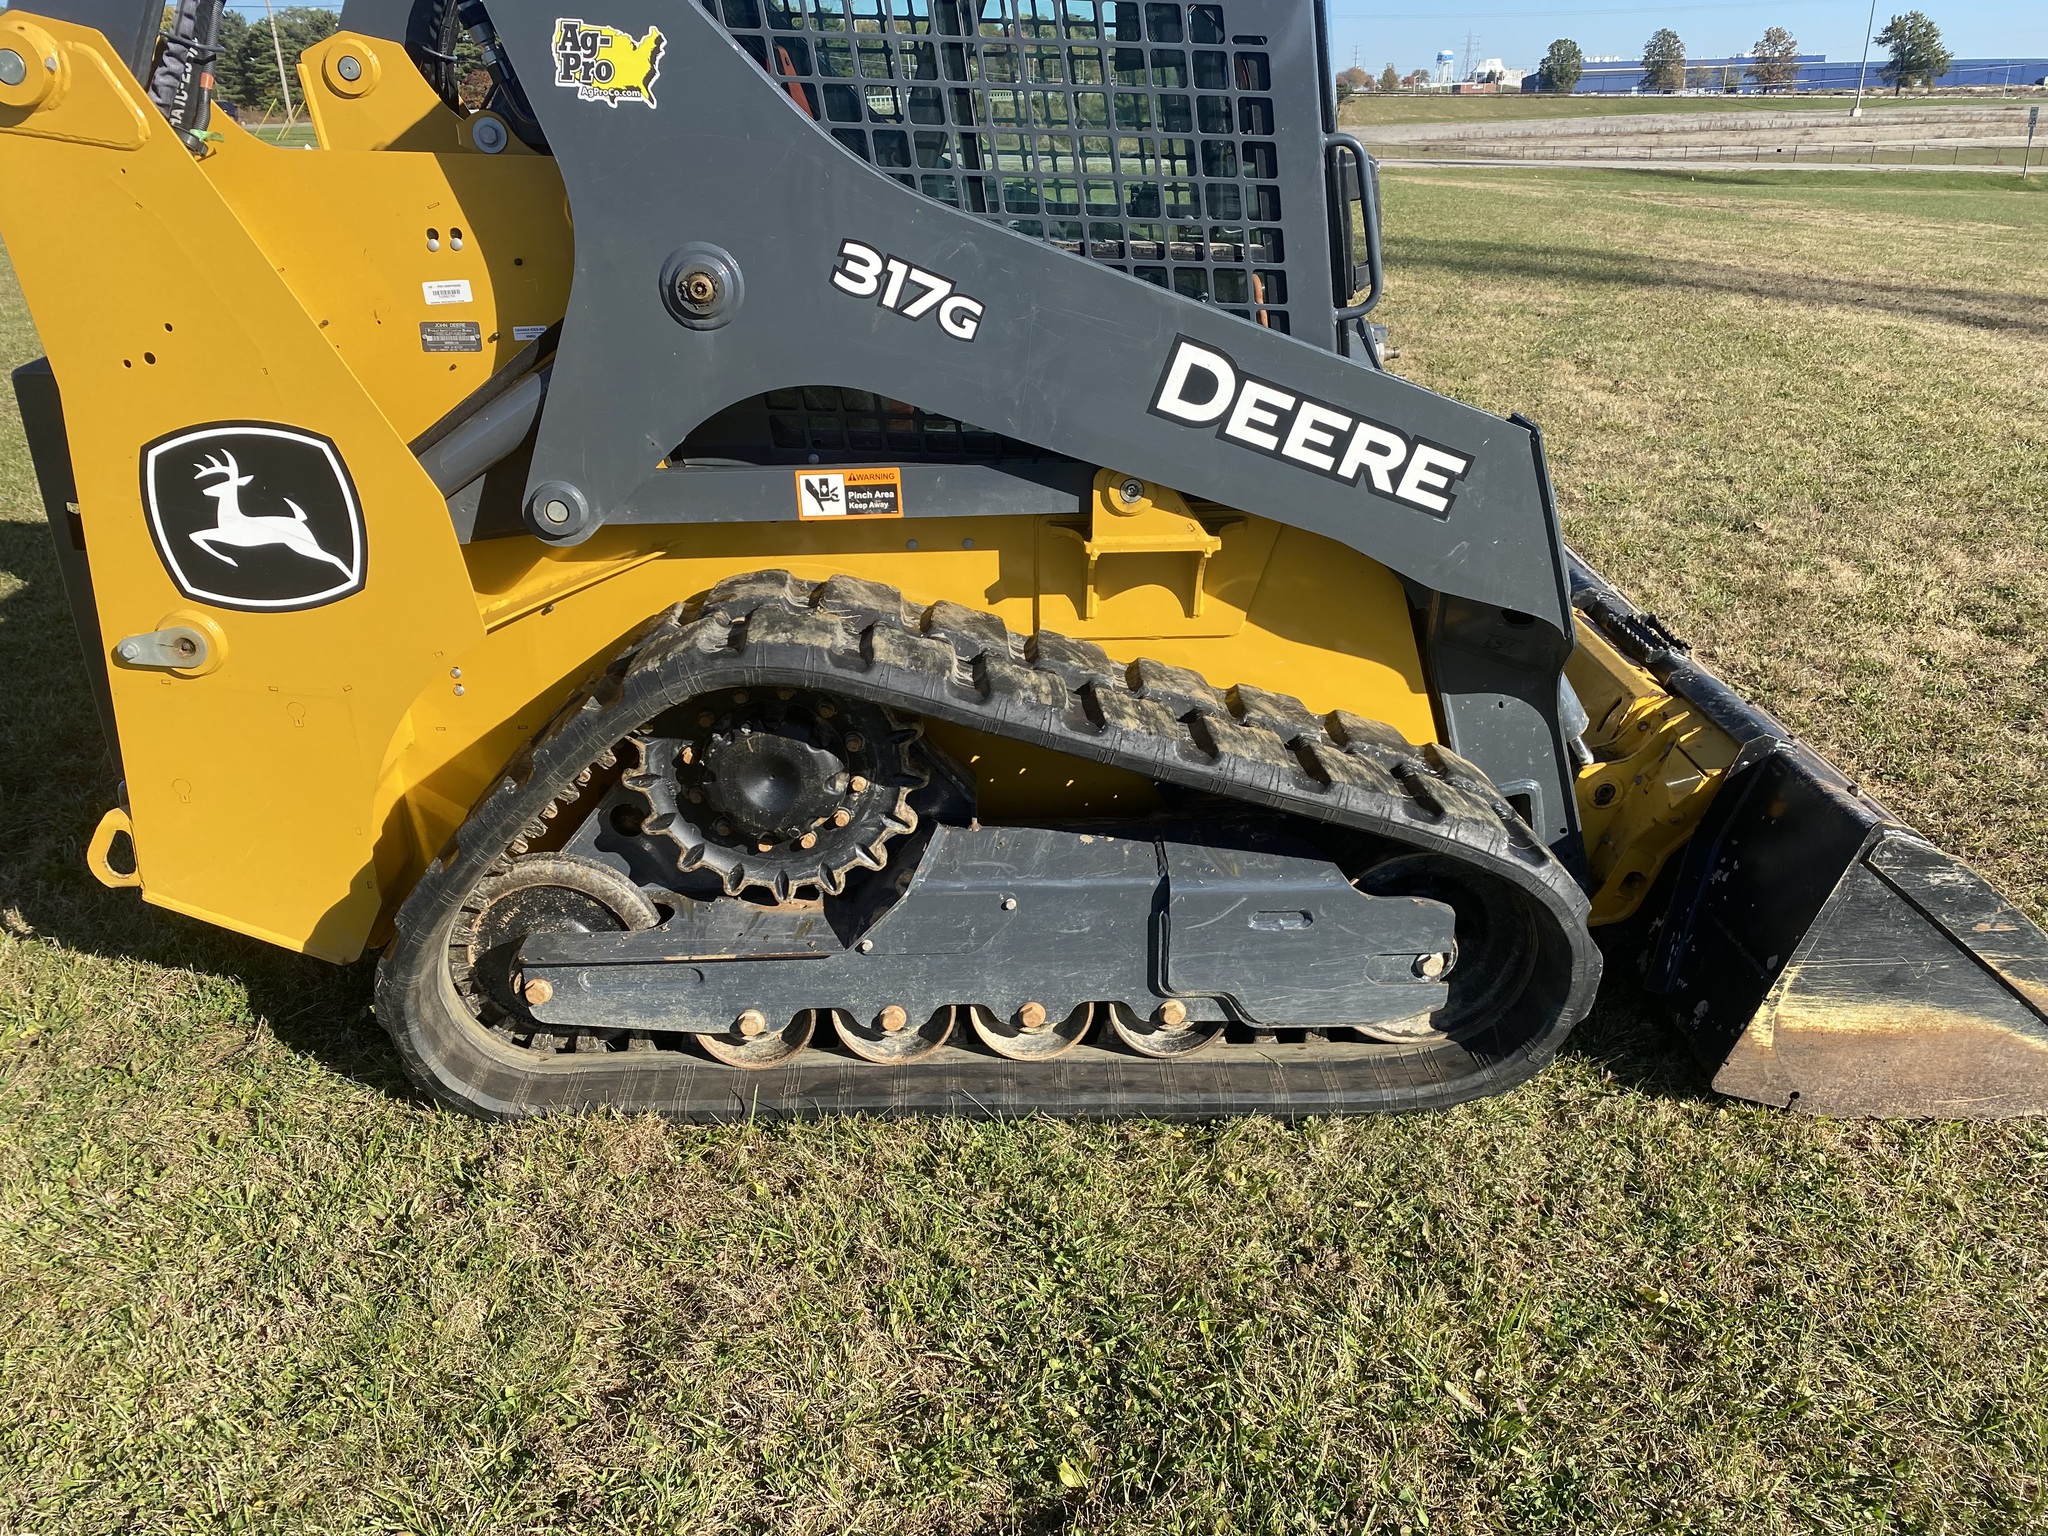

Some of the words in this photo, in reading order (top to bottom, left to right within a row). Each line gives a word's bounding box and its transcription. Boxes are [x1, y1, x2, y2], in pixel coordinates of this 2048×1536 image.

[558, 22, 611, 59] Ag-
[560, 52, 614, 81] Pro
[581, 86, 642, 98] AgProCo.com
[832, 241, 984, 341] 317G
[1155, 341, 1467, 512] DEERE
[856, 472, 895, 481] WARNING
[848, 490, 873, 499] Pinch
[874, 490, 895, 498] Area
[848, 502, 868, 510] Keep
[868, 501, 889, 509] Away
